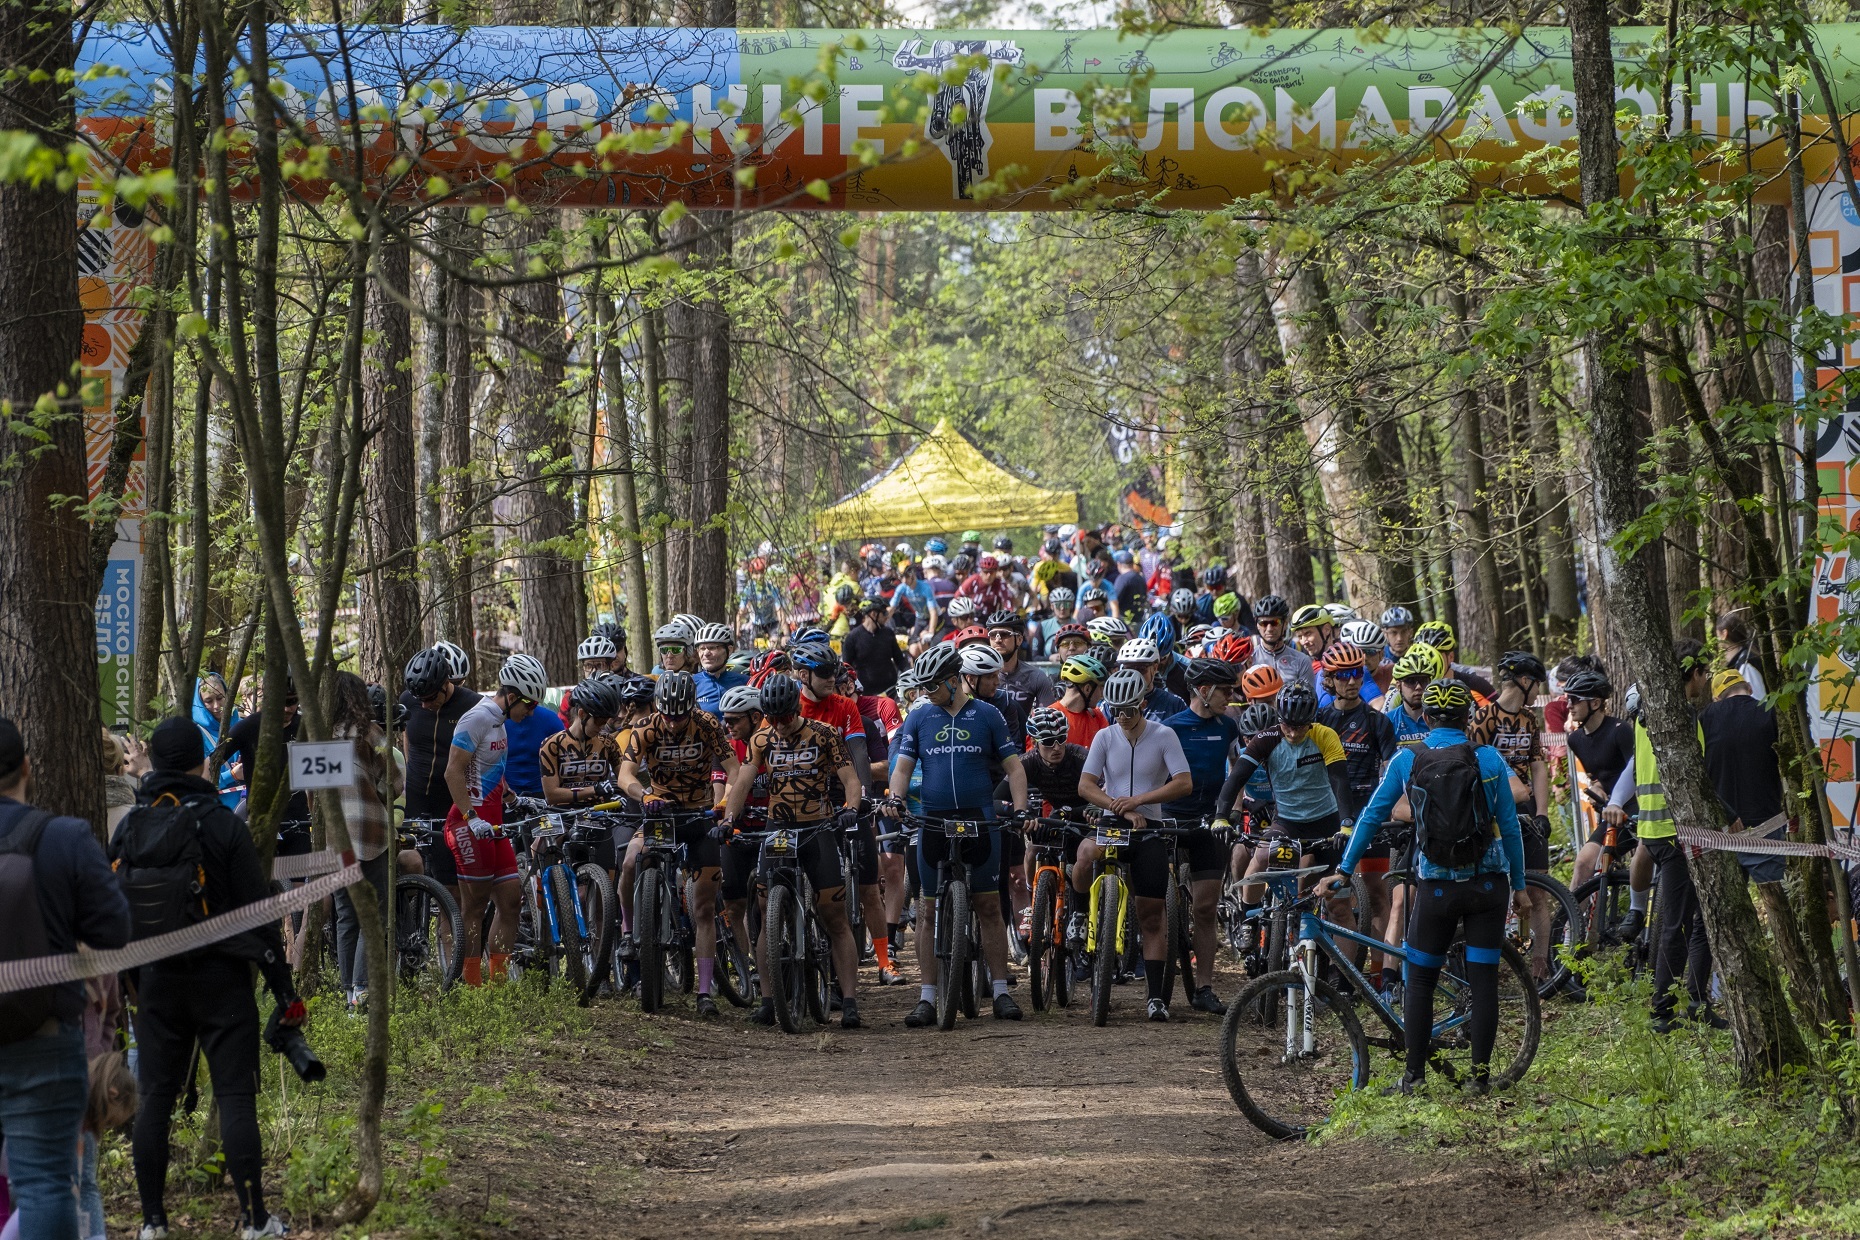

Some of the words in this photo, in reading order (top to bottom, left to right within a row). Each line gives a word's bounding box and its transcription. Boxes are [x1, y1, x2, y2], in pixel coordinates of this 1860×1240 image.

[116, 568, 130, 725] МОСКОВСКИЕ
[659, 748, 699, 759] PBO
[925, 745, 982, 756] veloman
[773, 751, 813, 763] PBO
[563, 763, 603, 775] PBO
[1260, 820, 1269, 828] 6
[1105, 829, 1122, 837] 14
[455, 825, 476, 865] RUSSIA
[773, 837, 788, 848] 12
[1276, 847, 1293, 860] 25
